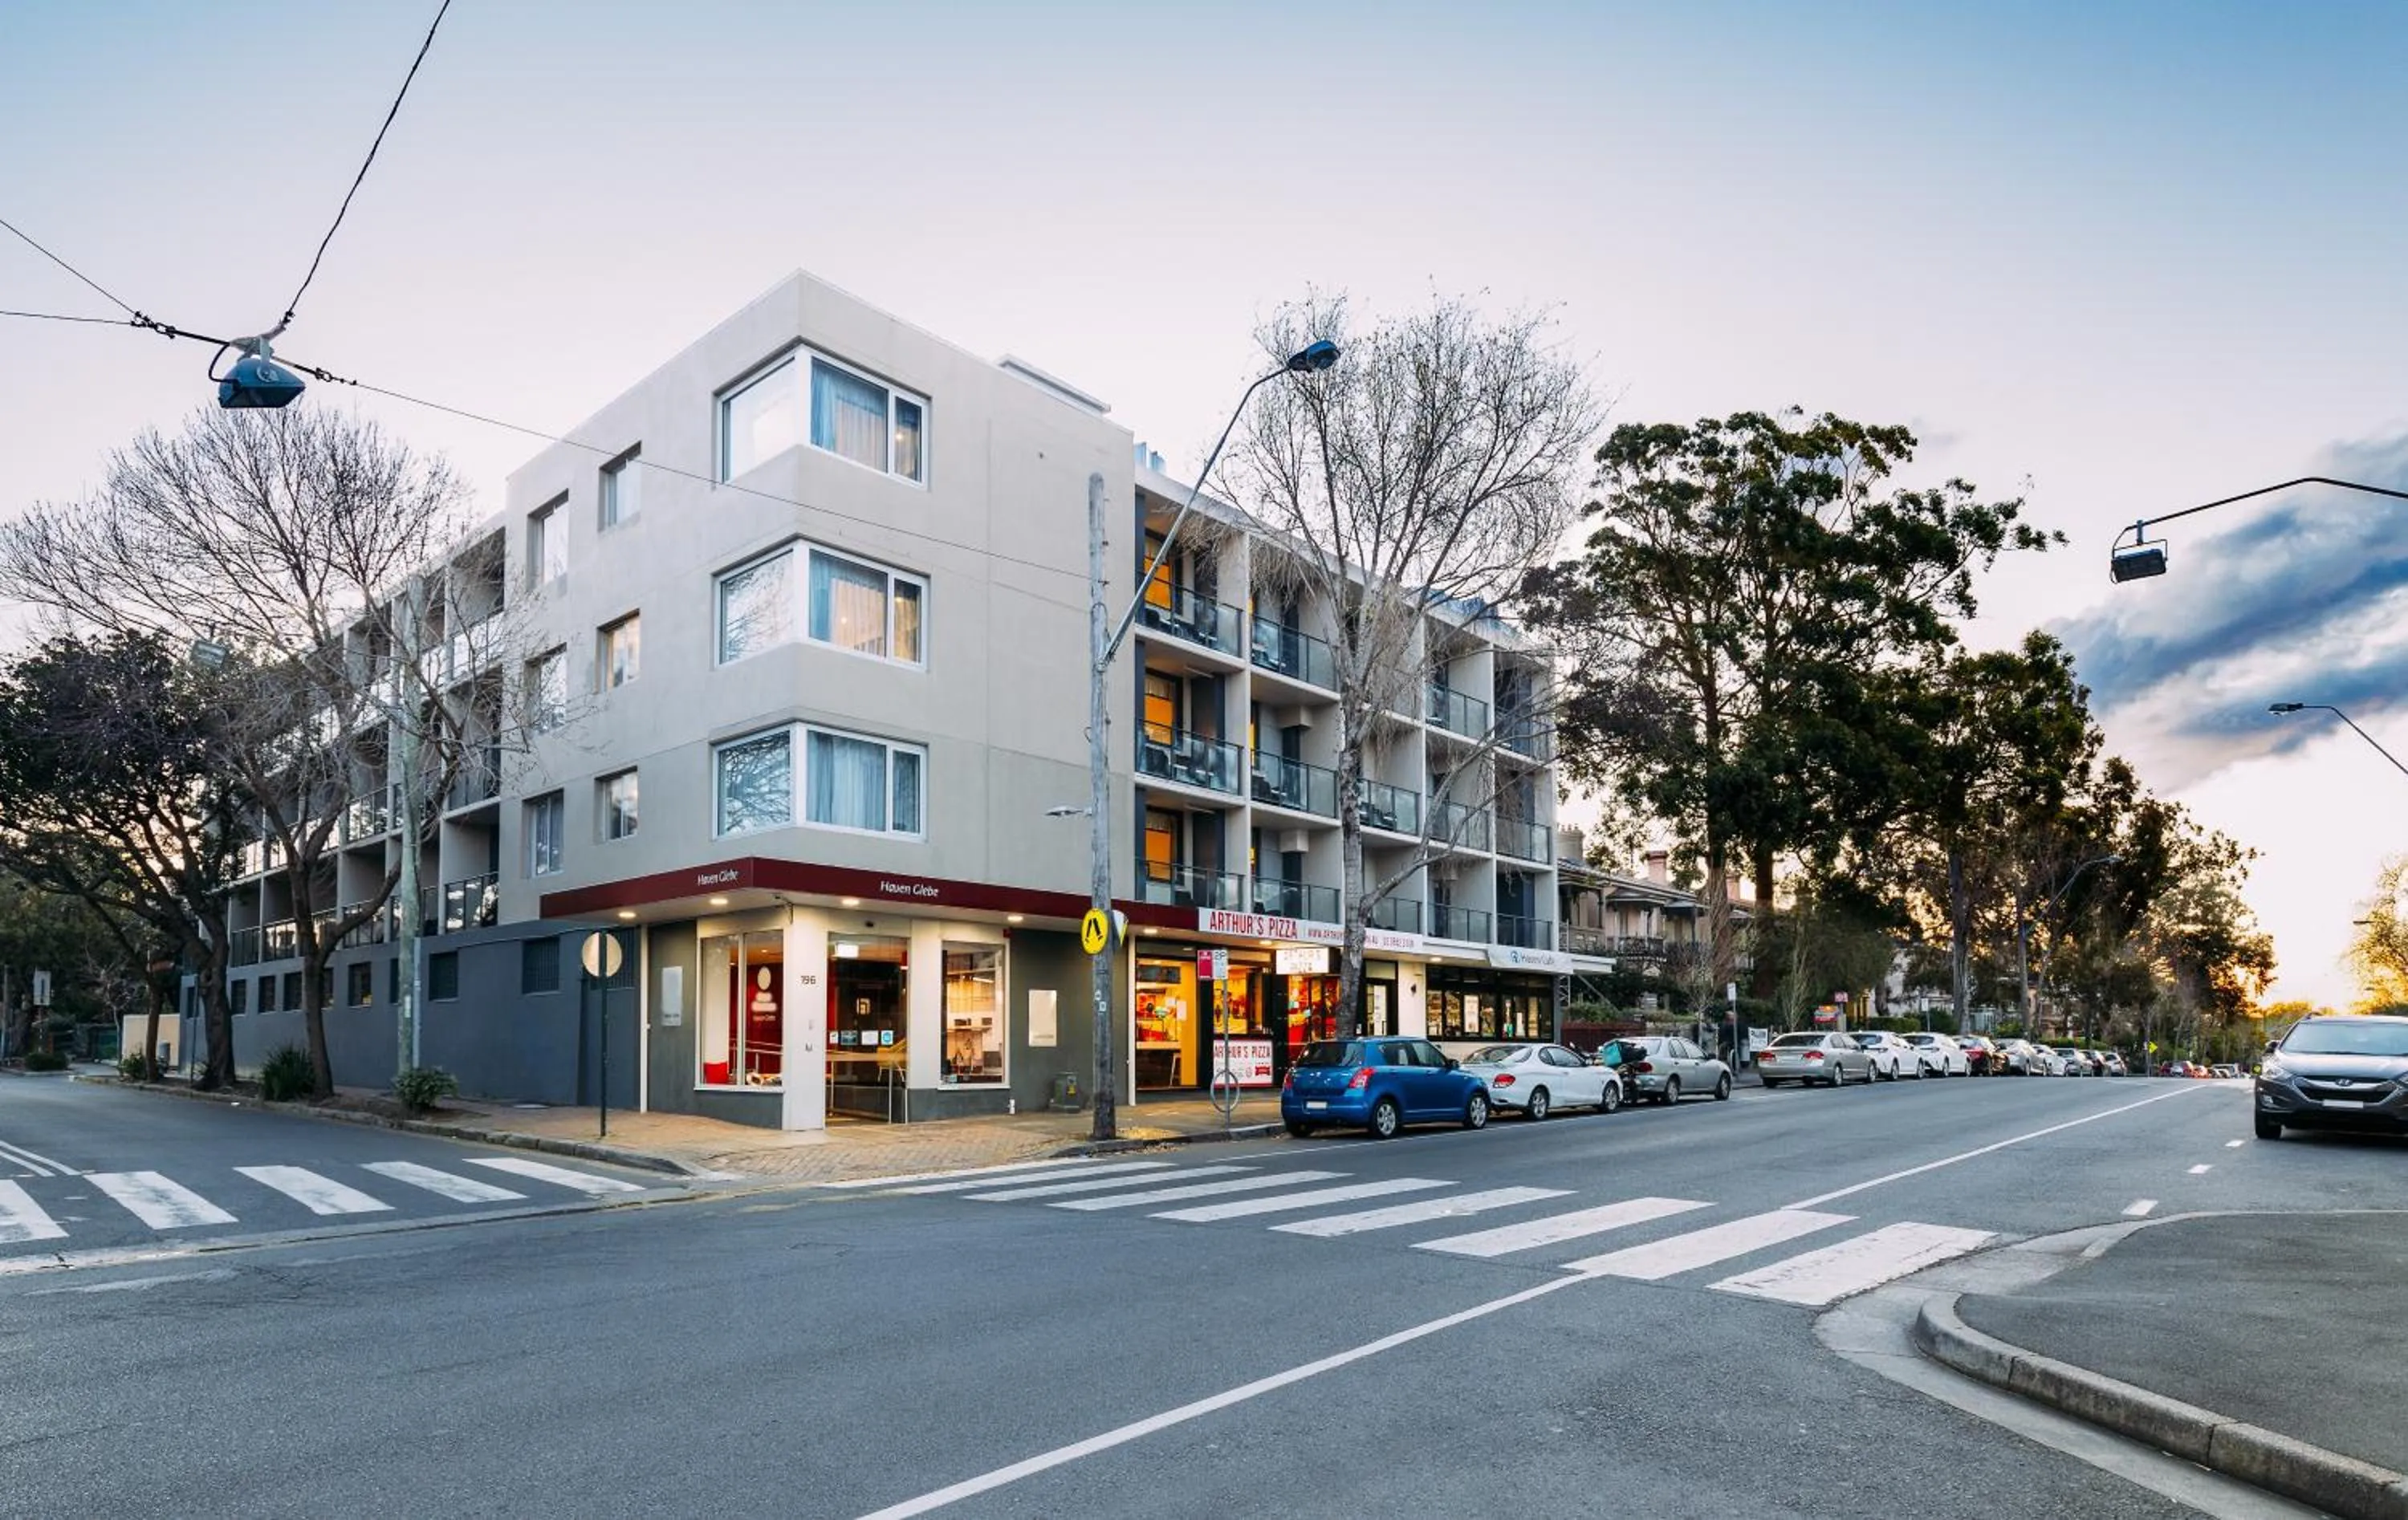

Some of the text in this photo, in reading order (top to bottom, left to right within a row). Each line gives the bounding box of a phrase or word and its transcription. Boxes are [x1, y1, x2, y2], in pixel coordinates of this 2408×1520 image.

[912, 884, 938, 897] Glebe
[1210, 911, 1265, 936] ARTHUR'S
[1268, 917, 1298, 940] PIZZA
[1251, 1046, 1271, 1059] PIZZA
